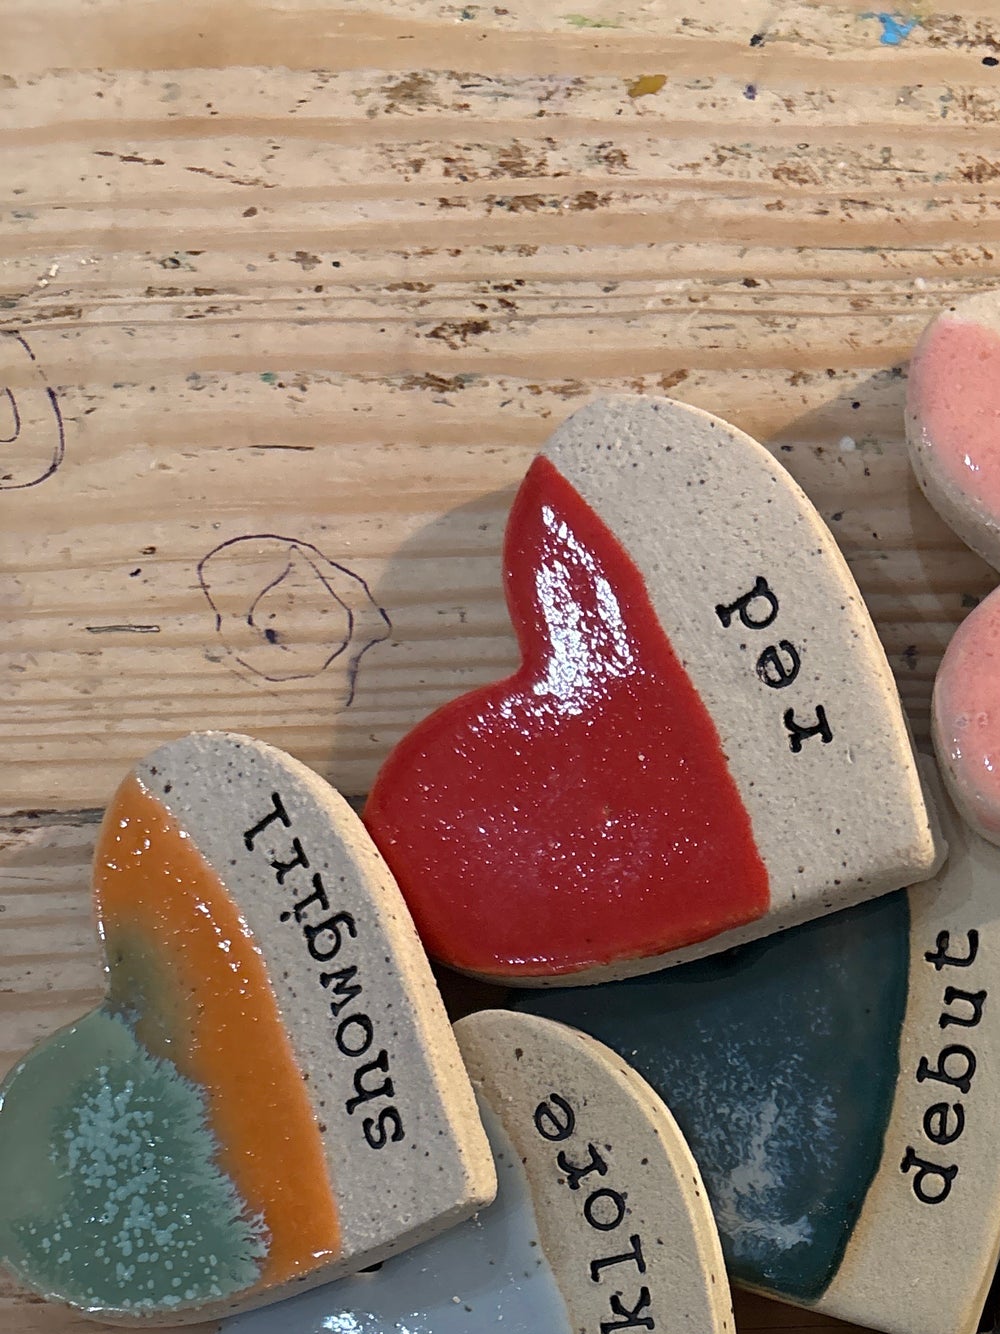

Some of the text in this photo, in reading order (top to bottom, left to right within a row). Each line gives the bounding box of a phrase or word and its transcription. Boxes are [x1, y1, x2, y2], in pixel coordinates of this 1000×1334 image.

[715, 576, 833, 753] red
[244, 792, 405, 1150] showgirl
[900, 929, 988, 1205] debut
